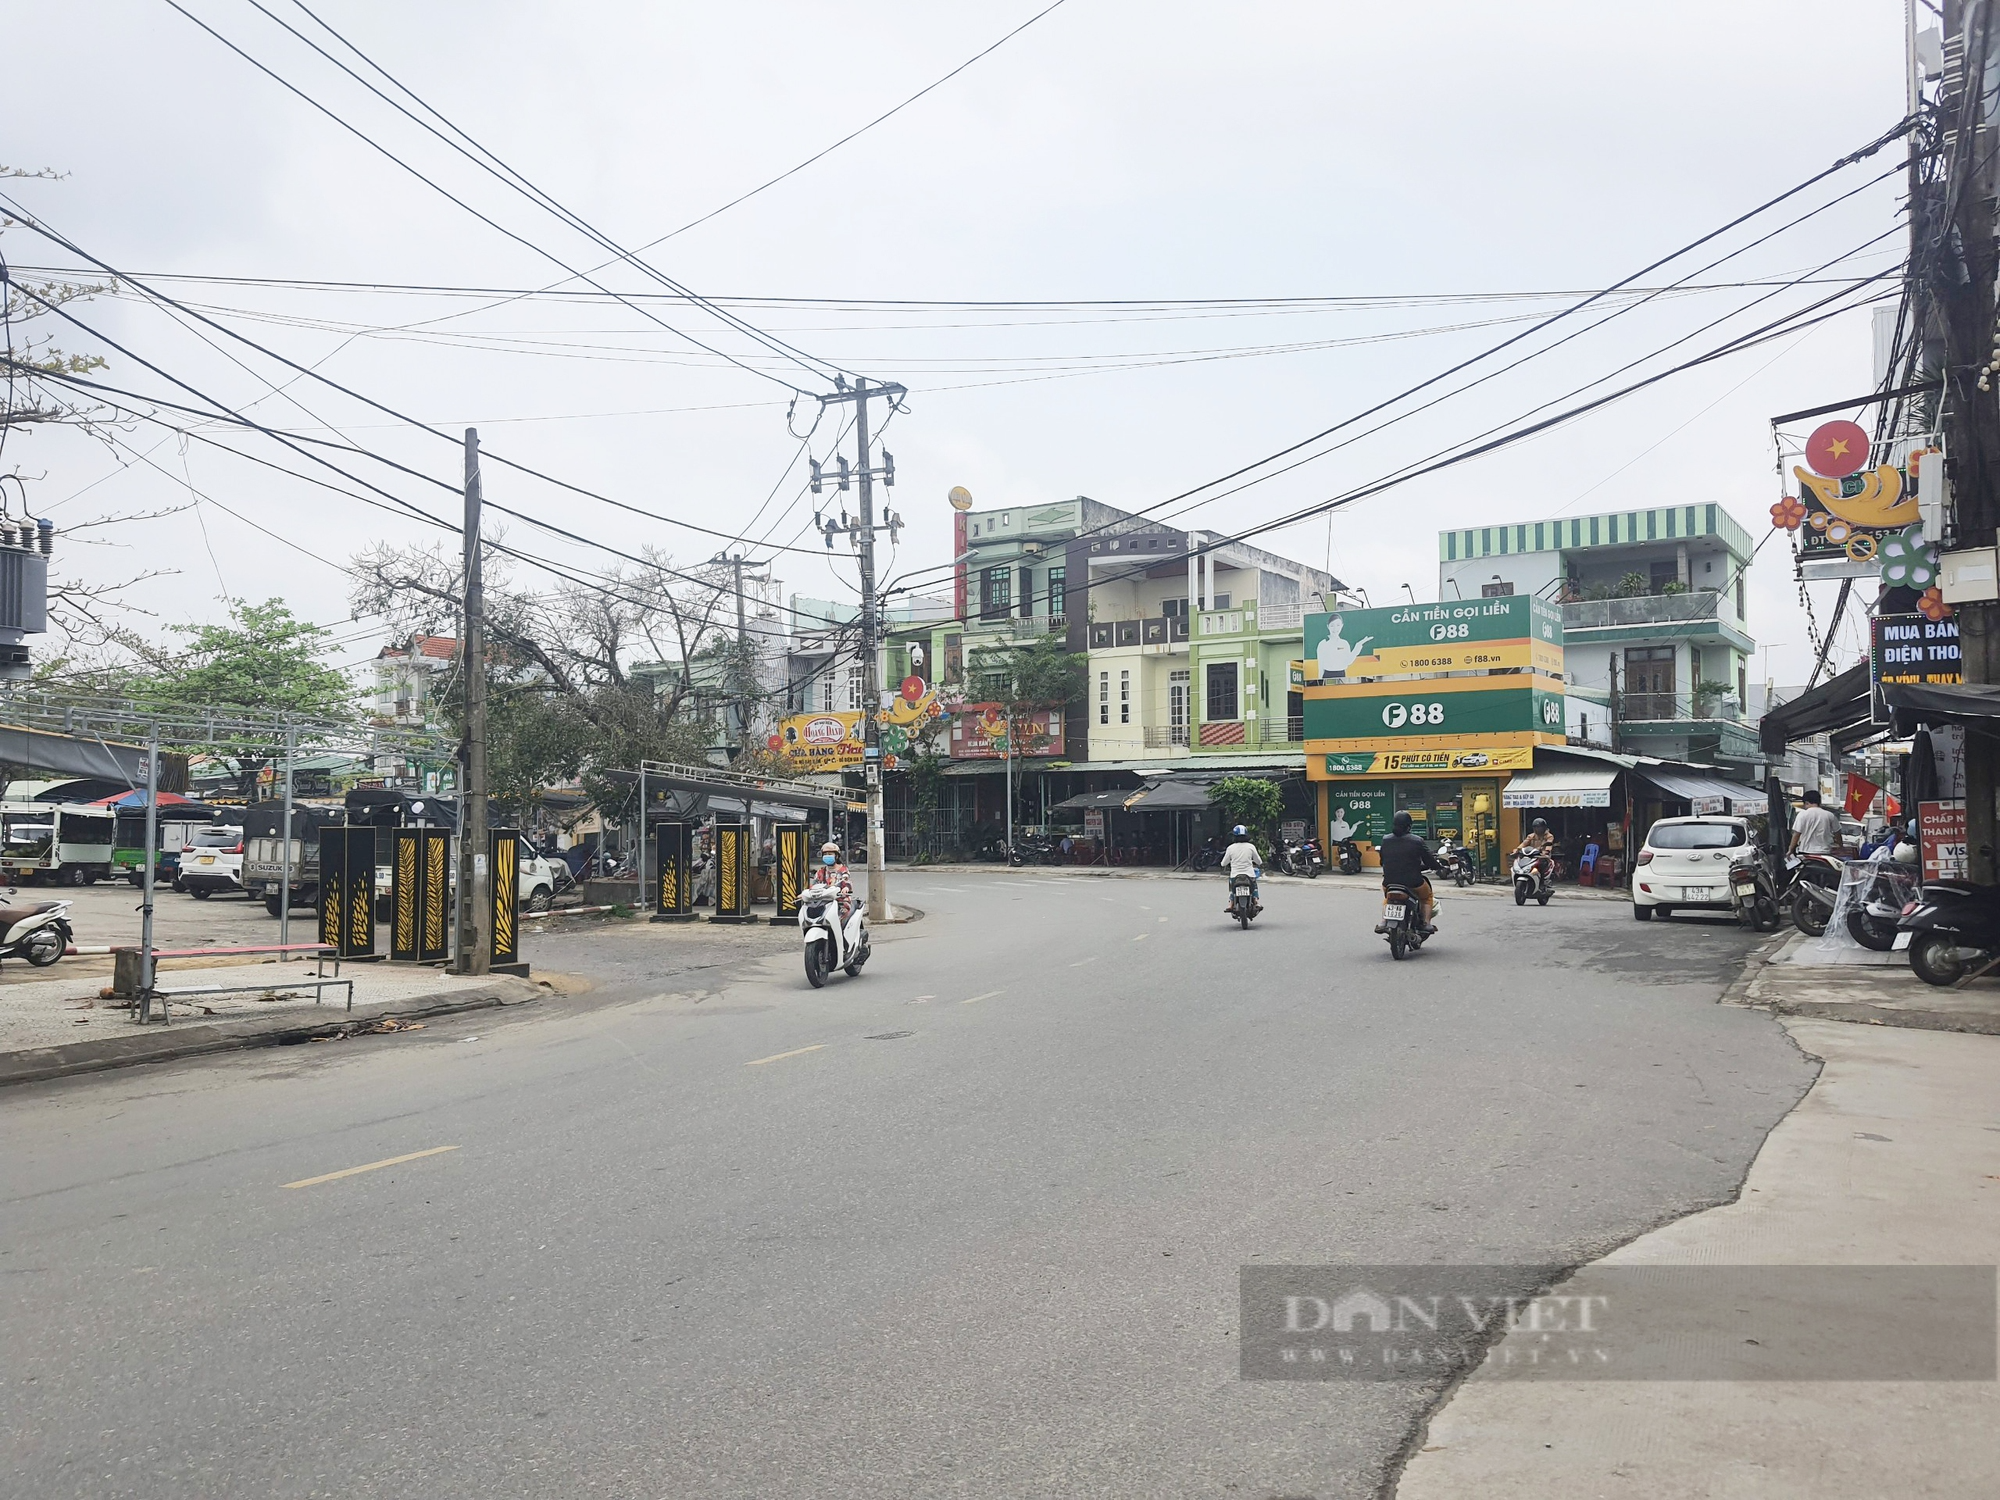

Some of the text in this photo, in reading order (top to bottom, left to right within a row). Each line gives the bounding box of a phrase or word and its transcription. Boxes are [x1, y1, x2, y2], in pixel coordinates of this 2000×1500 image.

[1391, 600, 1510, 623] CẦN TIỀN GỌI LIỀN
[1430, 623, 1469, 640] F88
[1884, 621, 1959, 640] MUA BÁN
[1410, 658, 1452, 667] 1800 6388
[1474, 655, 1501, 663] f88.vn
[1885, 645, 1923, 664] ĐIỆN
[1382, 702, 1445, 728] F88
[1543, 699, 1560, 724] F88
[1384, 755, 1400, 769] 15
[1401, 753, 1420, 762] PHÚT
[1421, 753, 1432, 762] CÓ
[1349, 800, 1371, 810] F88
[1539, 796, 1554, 805] BA
[1924, 812, 1953, 824] CHẤP
[1922, 827, 1957, 836] THANH
